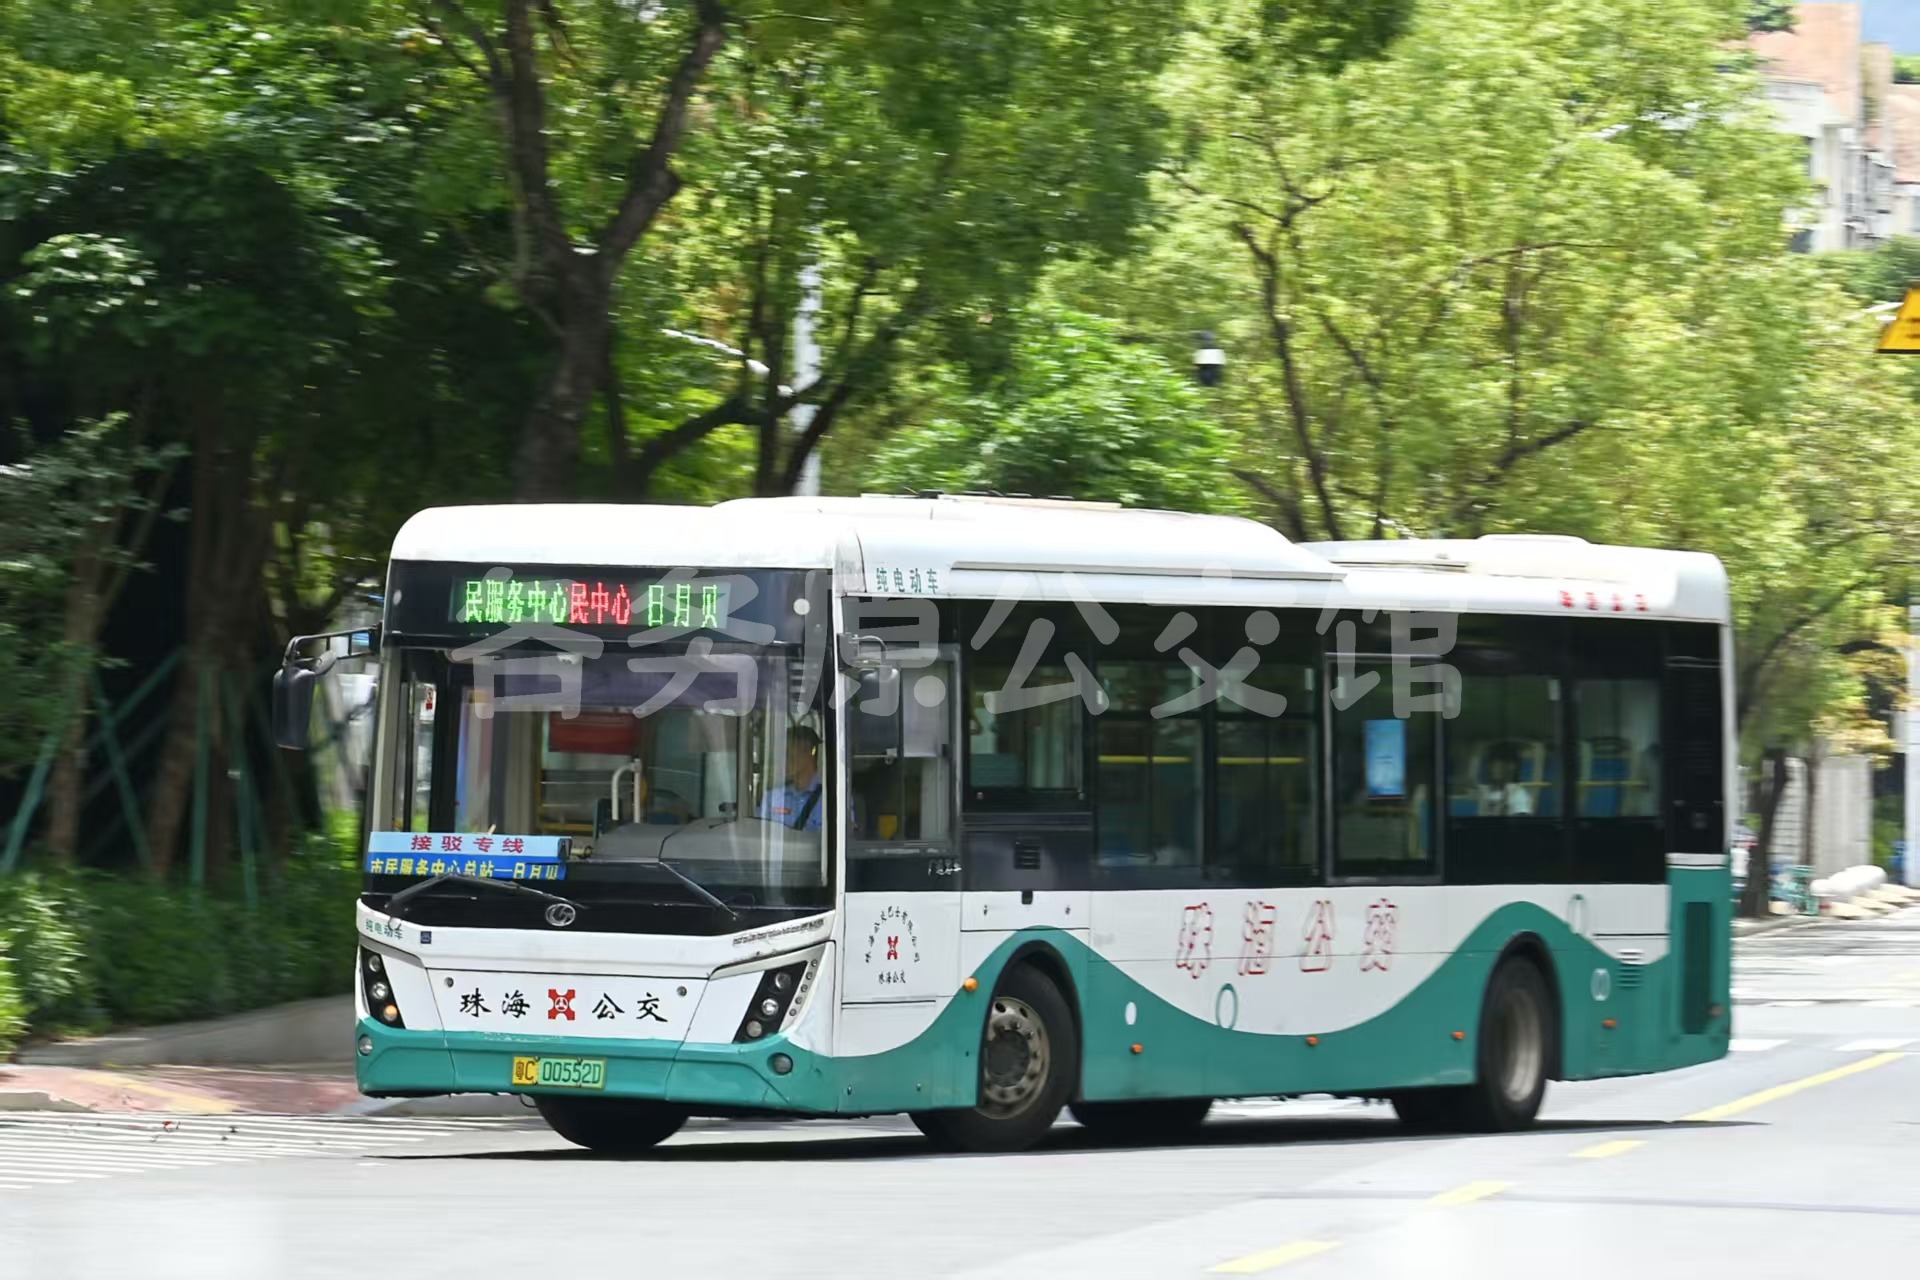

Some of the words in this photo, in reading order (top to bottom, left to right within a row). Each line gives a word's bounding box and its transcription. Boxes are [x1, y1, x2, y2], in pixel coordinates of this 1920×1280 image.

[647, 583, 719, 628] 日月贝
[411, 834, 525, 854] 接驳专线
[459, 987, 532, 1019] 珠海
[591, 991, 669, 1023] 公交
